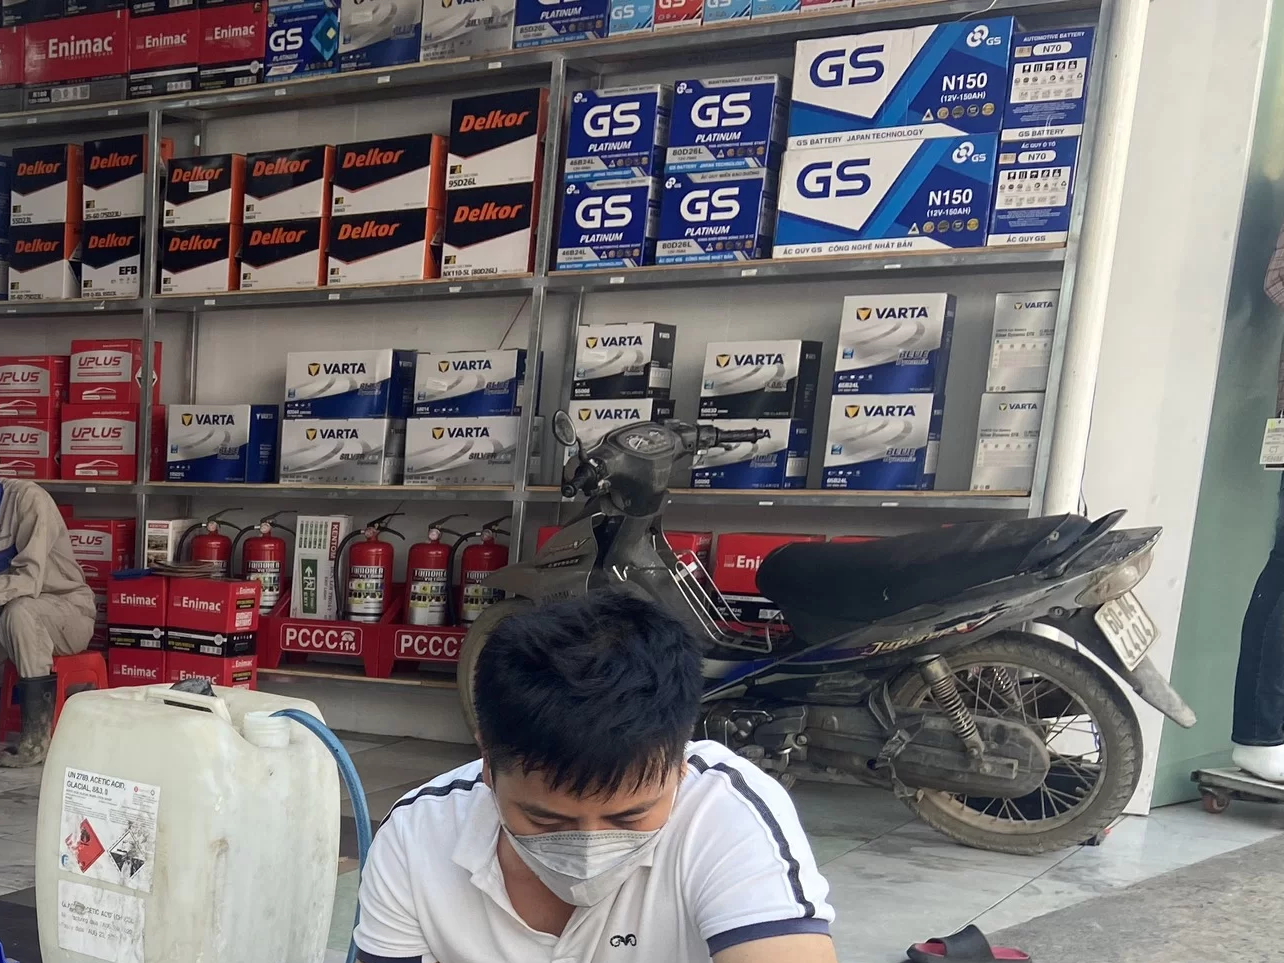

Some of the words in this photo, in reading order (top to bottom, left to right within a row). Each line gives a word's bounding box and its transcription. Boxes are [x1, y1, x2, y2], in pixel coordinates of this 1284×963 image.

[540, 6, 582, 20] PLATINUM
[612, 6, 635, 20] GS
[214, 22, 255, 41] Enimac
[1023, 34, 1058, 42] AUTOMOTIVE
[145, 30, 188, 49] Enimac
[269, 26, 303, 53] GS
[986, 36, 1001, 45] GS
[48, 34, 113, 59] Enimac
[1043, 44, 1061, 53] N70
[809, 44, 884, 88] GS
[942, 72, 988, 91] N150
[940, 91, 986, 103] (12V-150AH)
[691, 92, 751, 128] GS
[459, 110, 530, 133] Delkor
[583, 101, 641, 138] GS
[695, 132, 741, 143] PLATINUM
[810, 136, 842, 145] BATTERY
[846, 134, 870, 142] JAPAN
[872, 128, 924, 139] TECHNOLOGY
[588, 141, 632, 153] PLATINUM
[90, 153, 138, 170] Delkor
[342, 148, 403, 169] Delkor
[971, 153, 986, 162] GS
[17, 162, 61, 177] Delkor
[253, 157, 311, 177] Delkor
[172, 166, 224, 183] Delkor
[796, 158, 871, 199] GS
[448, 178, 477, 188] 95D26L
[928, 188, 973, 206] N150
[680, 187, 740, 222] GS
[454, 202, 523, 223] Delkor
[575, 195, 632, 229] GS
[250, 228, 308, 246] Delkor
[338, 221, 401, 240] Delkor
[685, 226, 730, 237] PLATINUM
[88, 234, 135, 249] Delkor
[168, 235, 222, 252] Delkor
[580, 233, 623, 243] PLATINUM
[16, 240, 60, 253] Delkor
[828, 243, 849, 252] CÔNG
[852, 242, 872, 250] NGHỆ
[119, 266, 138, 275] EFB
[876, 307, 928, 319] VARTA
[601, 336, 643, 347] VARTA
[734, 354, 784, 366] VARTA
[899, 350, 929, 359] BLUE
[78, 356, 121, 367] UPLUS
[452, 360, 492, 371] VARTA
[323, 362, 366, 375] VARTA
[594, 408, 641, 420] VARTA
[863, 405, 916, 417] VARTA
[195, 414, 235, 426] VARTA
[71, 427, 123, 439] UPLUS
[320, 429, 359, 439] VARTA
[447, 427, 490, 438] VARTA
[886, 448, 916, 456] BLUE
[737, 555, 763, 569] Eni
[121, 593, 156, 605] Enimac
[182, 597, 221, 611] Enimac
[285, 627, 338, 649] PCCC
[1120, 615, 1152, 660] 4404
[339, 641, 356, 651] 114
[401, 634, 458, 657] PCCC
[122, 665, 156, 677] Enimac
[66, 781, 91, 792] GLACIAL,
[90, 776, 110, 786] ACETIC
